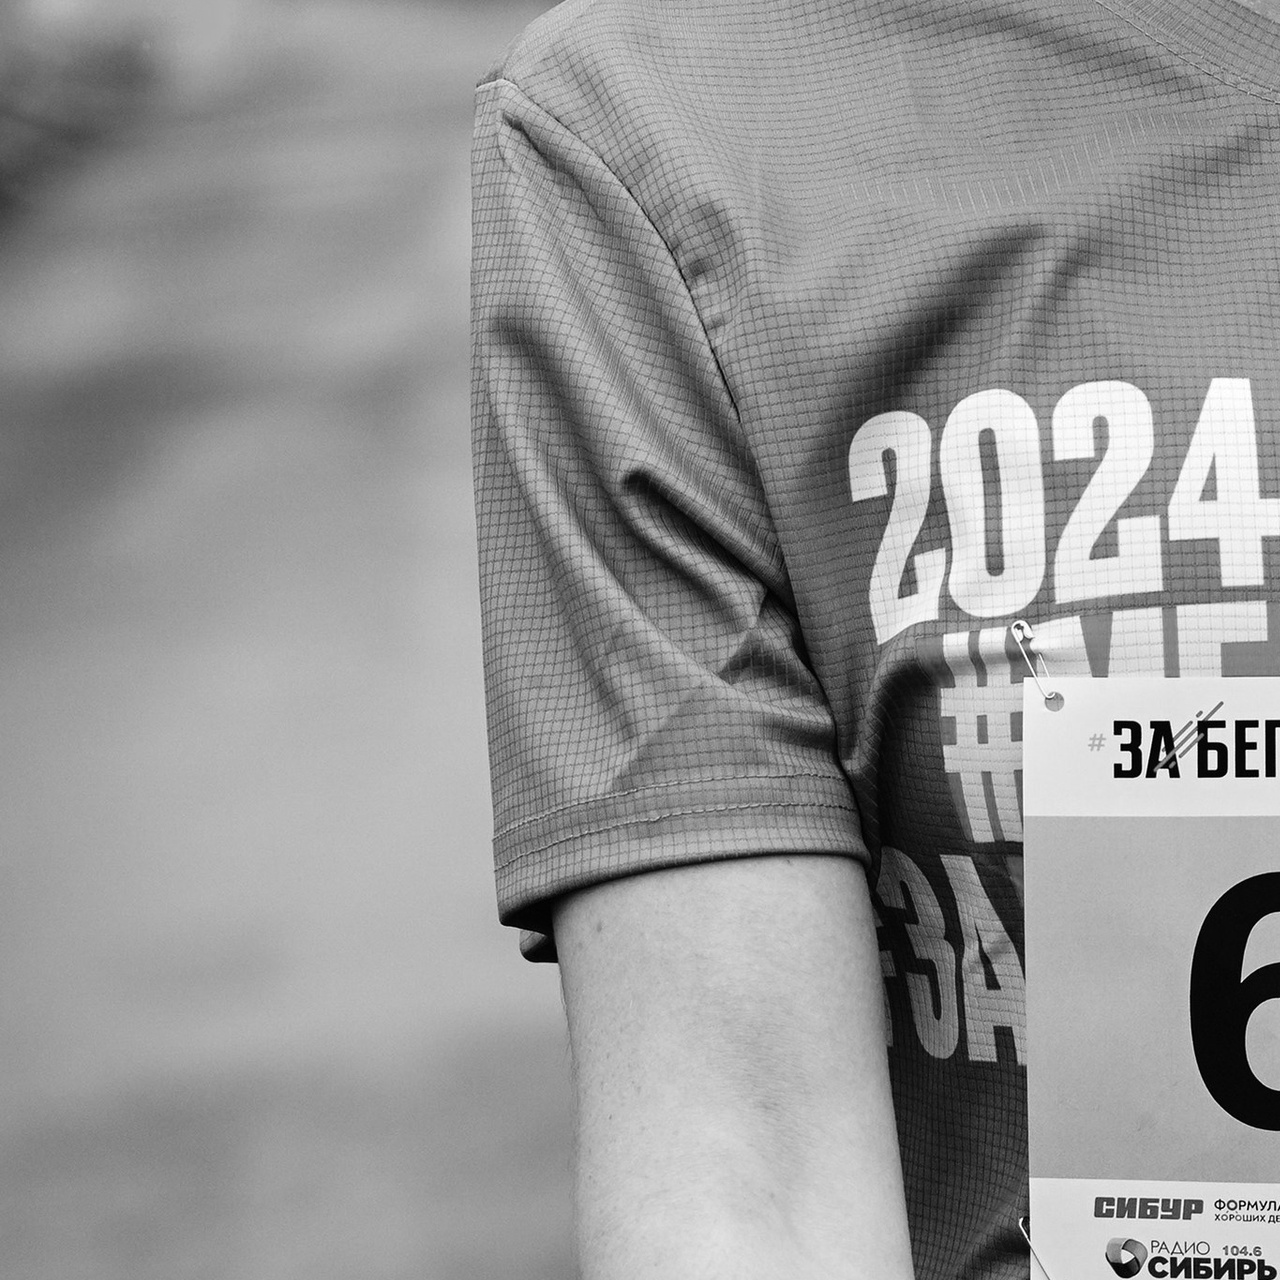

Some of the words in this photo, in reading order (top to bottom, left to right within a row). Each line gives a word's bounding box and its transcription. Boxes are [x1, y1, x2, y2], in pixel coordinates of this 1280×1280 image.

[1094, 1197, 1204, 1220] СИБУР
[1214, 1212, 1266, 1223] ХОРОШИХ
[1150, 1240, 1211, 1256] РАДИО
[1222, 1245, 1263, 1257] 104.6
[1148, 1256, 1278, 1280] СИБИРЬ
